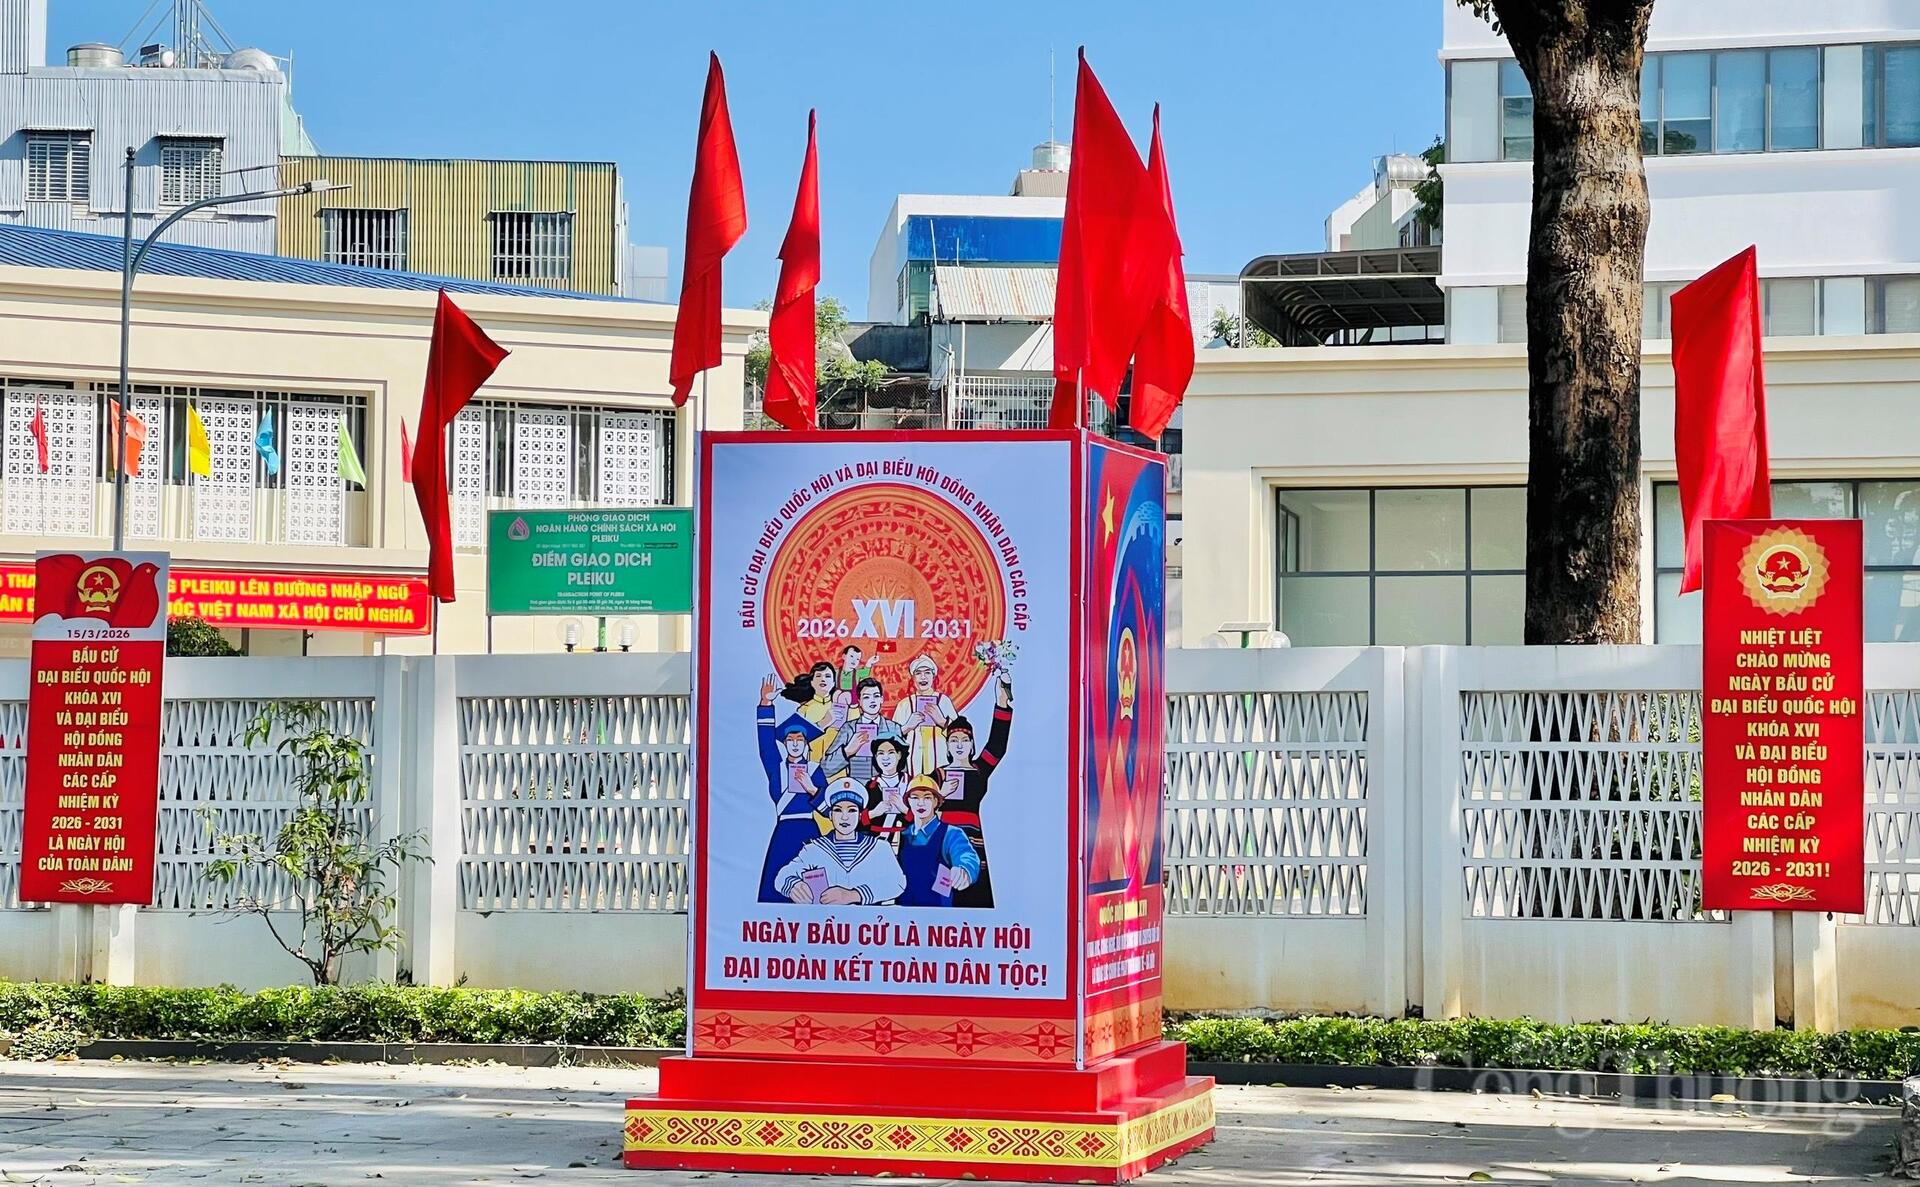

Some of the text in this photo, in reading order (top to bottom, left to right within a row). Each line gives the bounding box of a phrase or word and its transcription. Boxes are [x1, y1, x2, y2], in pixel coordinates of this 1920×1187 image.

[567, 513, 650, 523] PHÒNG GIAO DỊCH
[591, 535, 620, 543] PLEIKU
[737, 456, 1032, 631] BẦU CỬ ĐẠI BIỂU QUỐC HỘI VÀ ĐẠI BIỂU HỘI ĐỒNG NHÂN DÂN CÁC CẤP
[532, 550, 652, 568] ĐIỂM GIAO DỊCH
[567, 572, 615, 586] PLEIKU
[180, 579, 235, 595] PLEIKU
[240, 576, 270, 595] LÊN
[274, 578, 327, 598] ĐƯỜNG
[331, 580, 372, 602] NHẬP
[377, 582, 409, 601] NGŨ
[198, 600, 232, 619] VIỆT
[237, 602, 274, 618] NAM
[278, 602, 300, 618] XÃ
[303, 603, 329, 622] HỘI
[333, 602, 364, 621] CHỦ
[368, 605, 414, 624] NGHĨA
[797, 599, 971, 639] 2026 XVI 2031
[67, 629, 130, 639] 15/3/2026
[1740, 628, 1822, 648] NHIỆT LIỆT
[101, 646, 119, 663] CỬ
[1736, 651, 1831, 668] CHÀO MỪNG
[37, 666, 151, 687] ĐẠI BIỂU QUỐC HỘI
[1729, 671, 1835, 692] NGÀY BẦU CỬ
[65, 689, 121, 705] KHÓA XVI
[1711, 694, 1856, 718] ĐẠI BIỂU QUỐC HỘI
[56, 707, 128, 728] VÀ ĐẠI BIỂU
[1747, 720, 1819, 737] KHÓA XVI
[64, 729, 122, 749] HỘI ĐỒNG
[58, 751, 123, 767] NHÂN DÂN
[1735, 740, 1827, 763] VÀ ĐẠI BIỂU
[63, 770, 117, 788] CÁC CẤP
[1746, 764, 1821, 786] HỘI ĐỒNG
[58, 793, 119, 811] NHIỆM KỲ
[1740, 789, 1823, 807] NHÂN DÂN
[52, 816, 82, 829] 2026
[93, 816, 123, 830] 2031
[1747, 810, 1816, 830] CÁC CẤP
[48, 834, 125, 853] LÀ NGÀY HỘI
[1743, 835, 1820, 856] NHIỆM KỲ
[38, 853, 133, 871] CỦA TOÀN DÂN!
[1732, 861, 1771, 876] 2026
[1786, 862, 1830, 878] 2031!
[742, 914, 1031, 954] NGÀY BẦU CỬ LÀ NGÀY HỘI
[724, 952, 1047, 991] ĐẠI ĐOÀN KẾT TOÀN DÂN TỘC!
